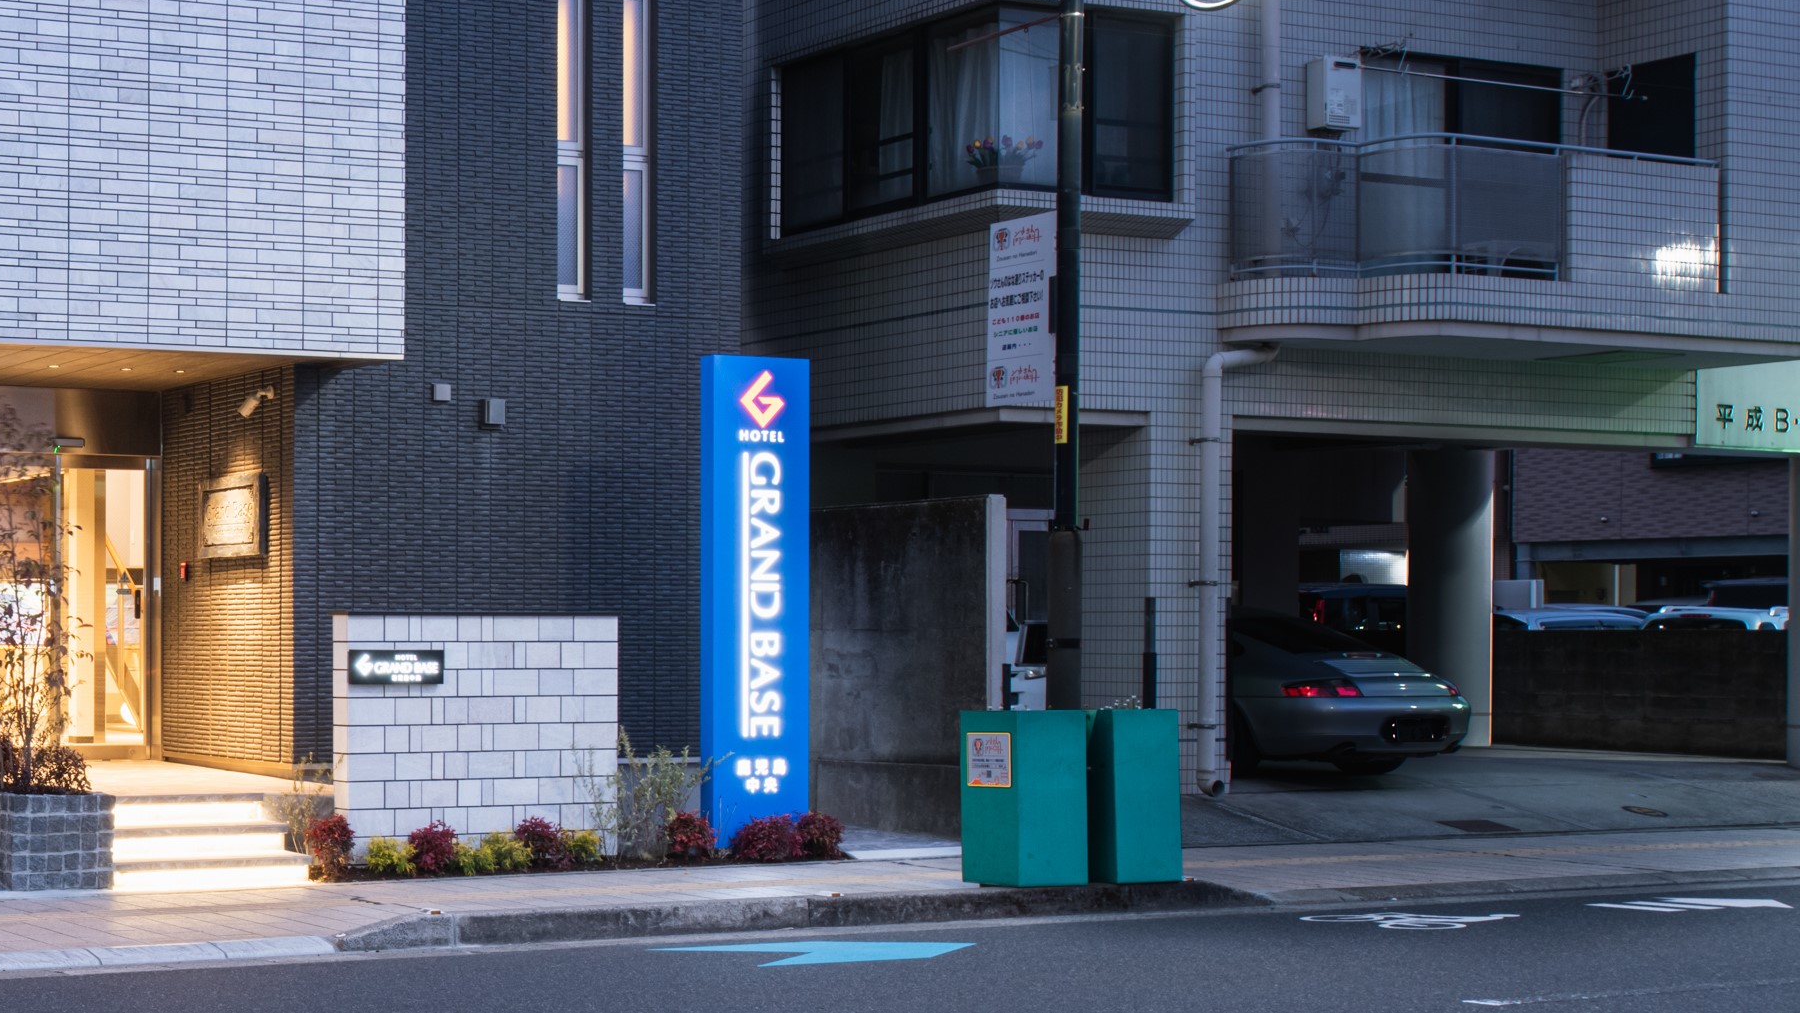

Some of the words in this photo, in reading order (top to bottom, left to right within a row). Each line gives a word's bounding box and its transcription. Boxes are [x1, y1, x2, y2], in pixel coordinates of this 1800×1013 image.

[739, 429, 784, 443] HOTEL
[750, 452, 780, 619] GRAND
[374, 661, 413, 674] GRAND
[413, 661, 439, 674] BASE
[750, 632, 780, 737] BASE
